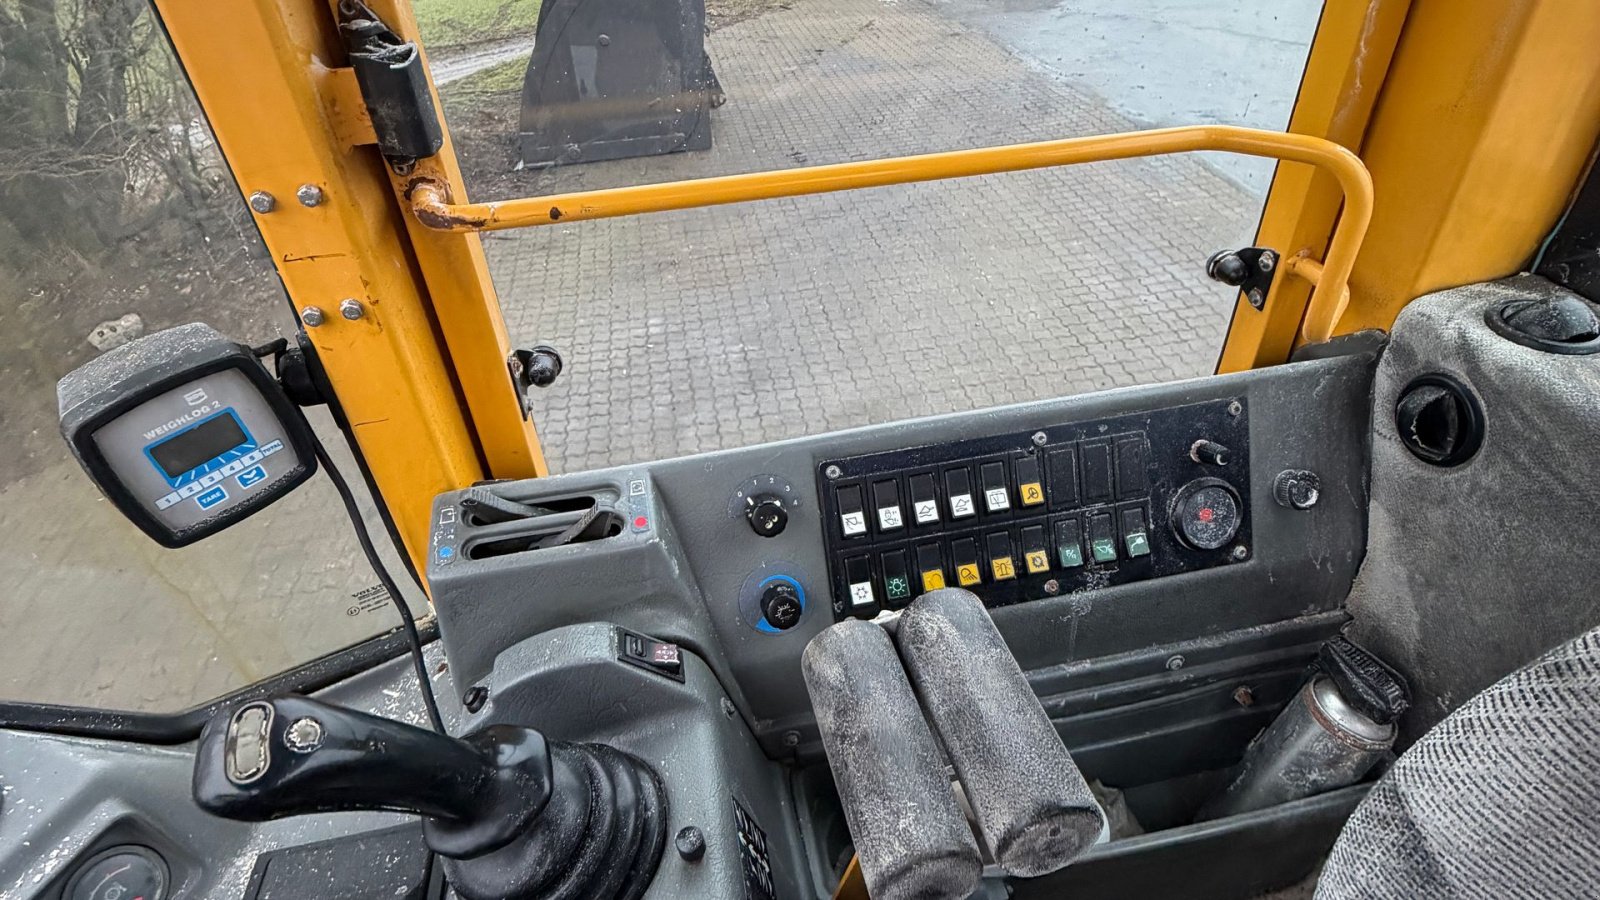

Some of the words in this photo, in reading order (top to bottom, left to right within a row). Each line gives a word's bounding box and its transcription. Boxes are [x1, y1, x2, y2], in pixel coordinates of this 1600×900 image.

[143, 406, 210, 440] WEIGHLOG
[263, 443, 281, 454] TOTAL
[201, 491, 222, 504] TARE
